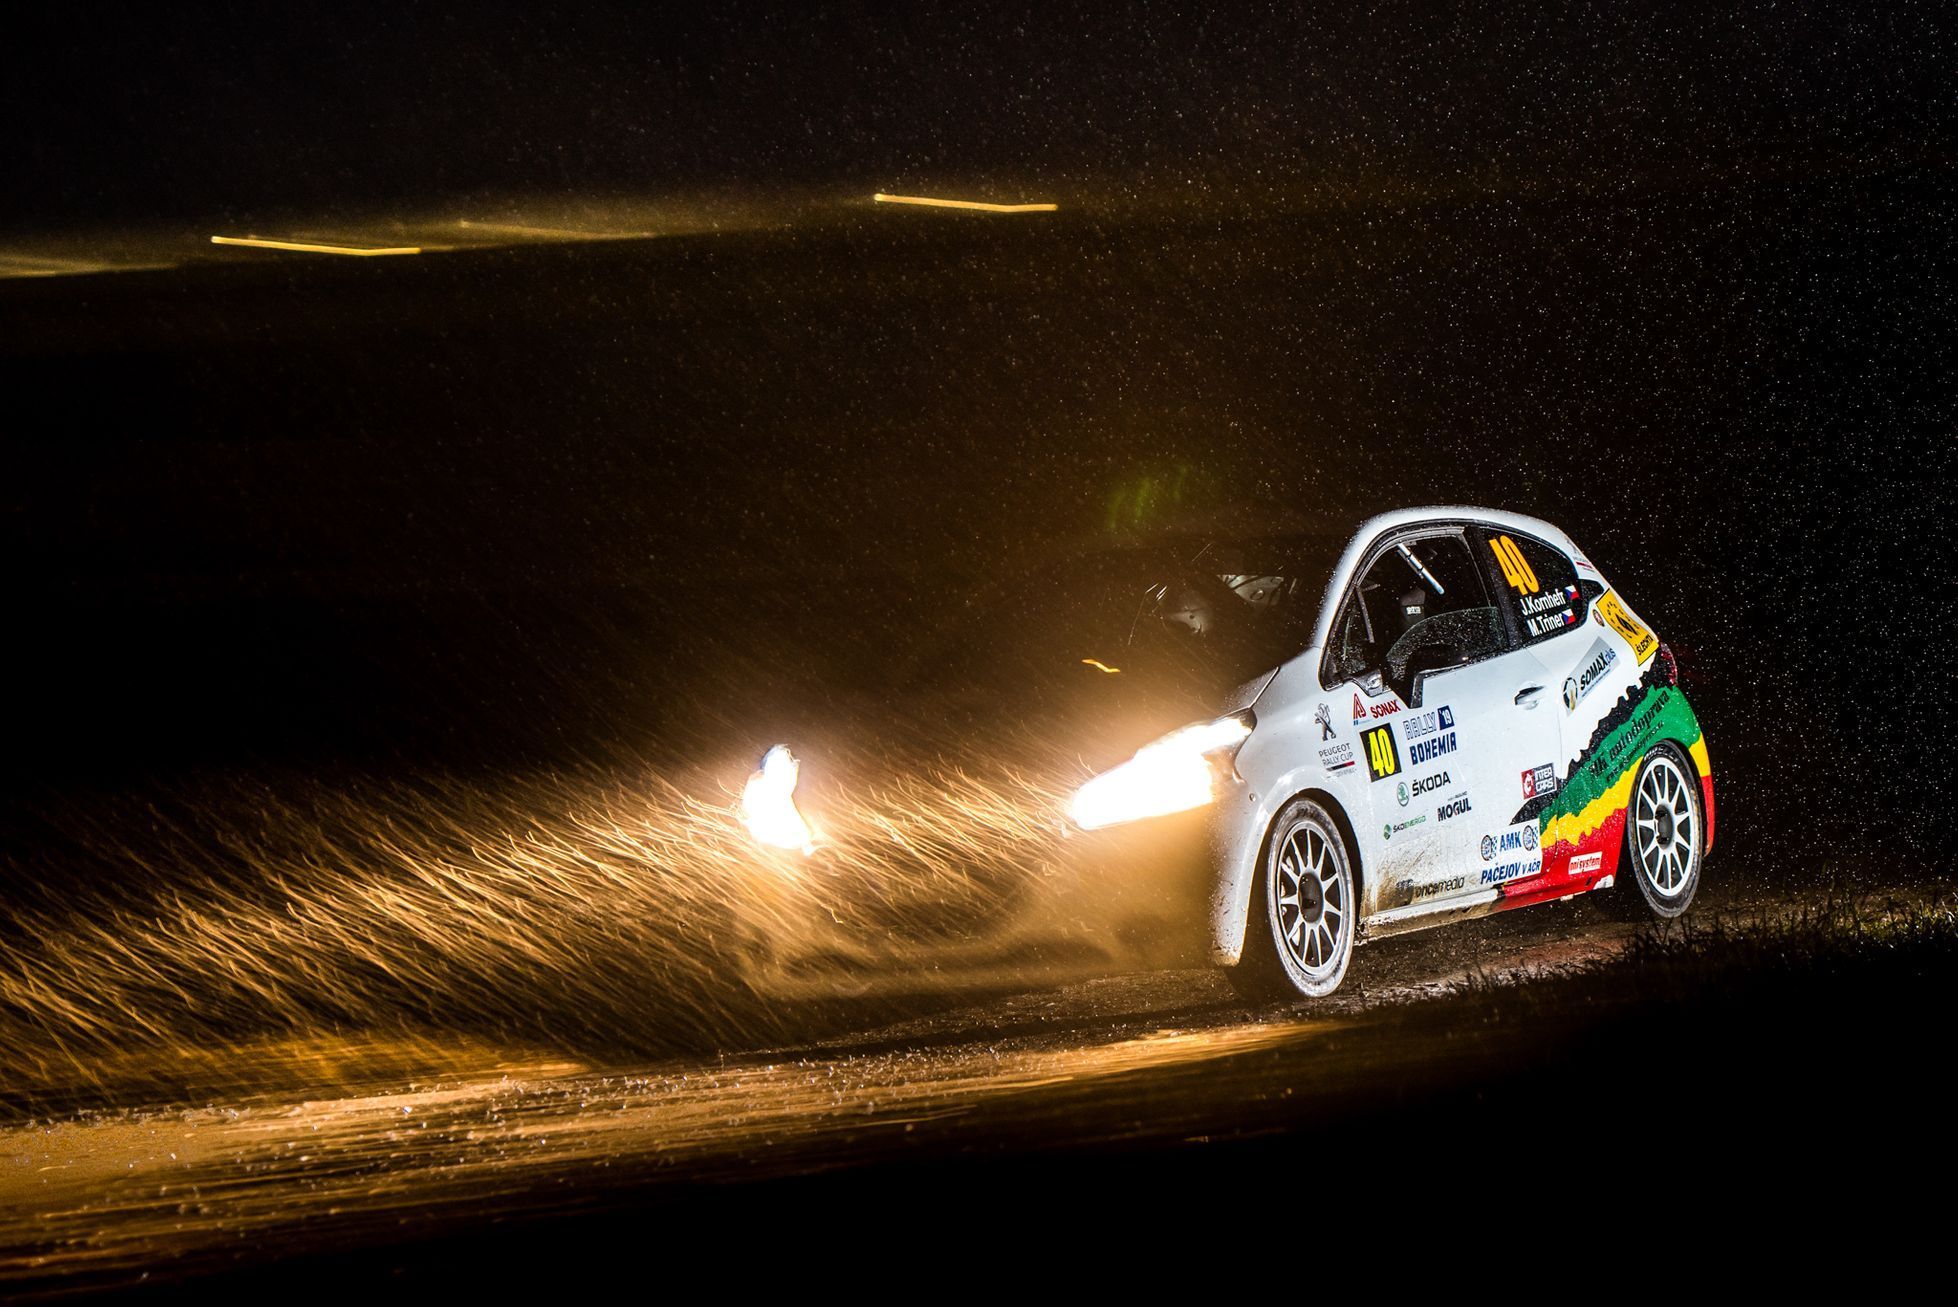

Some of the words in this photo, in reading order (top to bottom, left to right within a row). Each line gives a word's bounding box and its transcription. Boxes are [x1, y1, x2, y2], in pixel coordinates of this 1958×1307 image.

[1489, 535, 1540, 596] 40
[1527, 613, 1566, 637] M.Triner
[1580, 652, 1608, 691] SOMAX
[1370, 699, 1401, 719] SONAX
[1403, 711, 1437, 740] RALLY
[1318, 742, 1351, 758] PEUGEOT
[1322, 755, 1341, 767] RALLY
[1340, 751, 1354, 763] CUP
[1368, 728, 1396, 777] 40
[1409, 731, 1457, 765] BOHEMIA
[1412, 770, 1451, 797] ŠKODA
[1437, 797, 1472, 822] MOGUL
[1499, 831, 1522, 852] AMK
[1480, 861, 1522, 885] PAČEJOV
[1527, 858, 1541, 873] AČR
